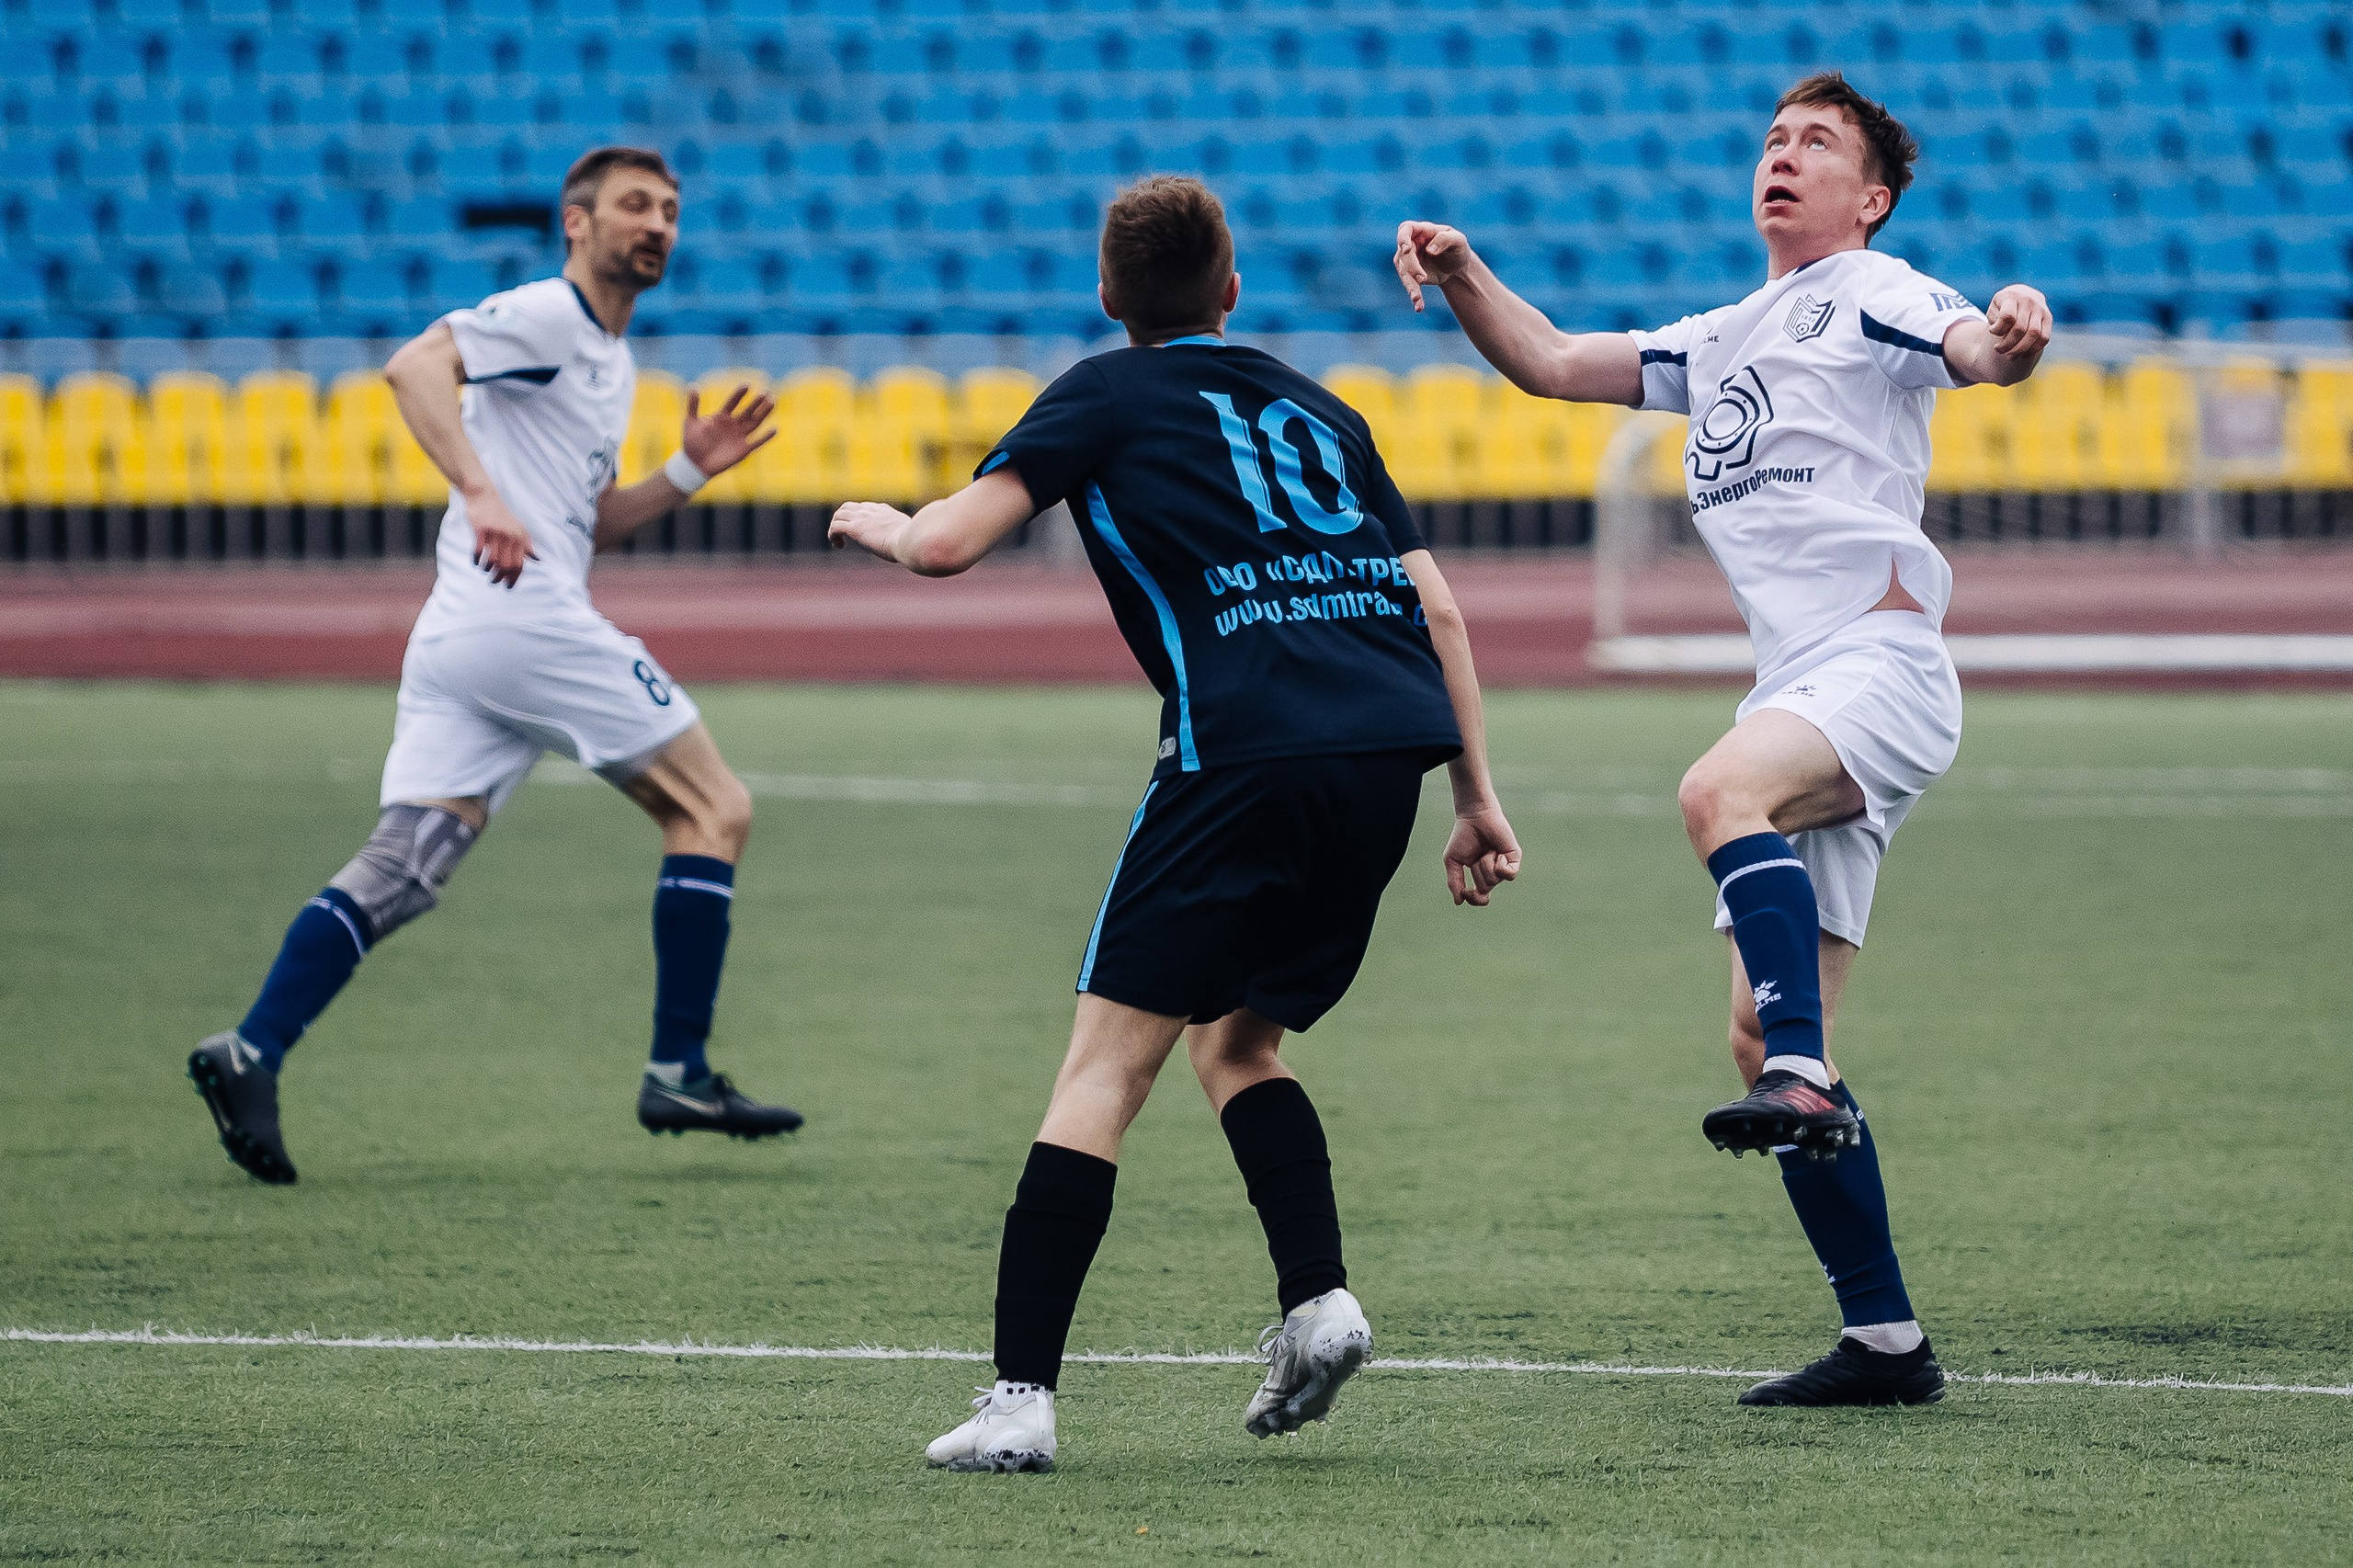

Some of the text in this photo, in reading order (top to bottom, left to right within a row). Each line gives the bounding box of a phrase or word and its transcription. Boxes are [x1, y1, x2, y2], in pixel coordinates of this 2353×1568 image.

[1199, 391, 1364, 535] 10
[633, 659, 671, 706] 8
[1755, 993, 1782, 1014] ELME
